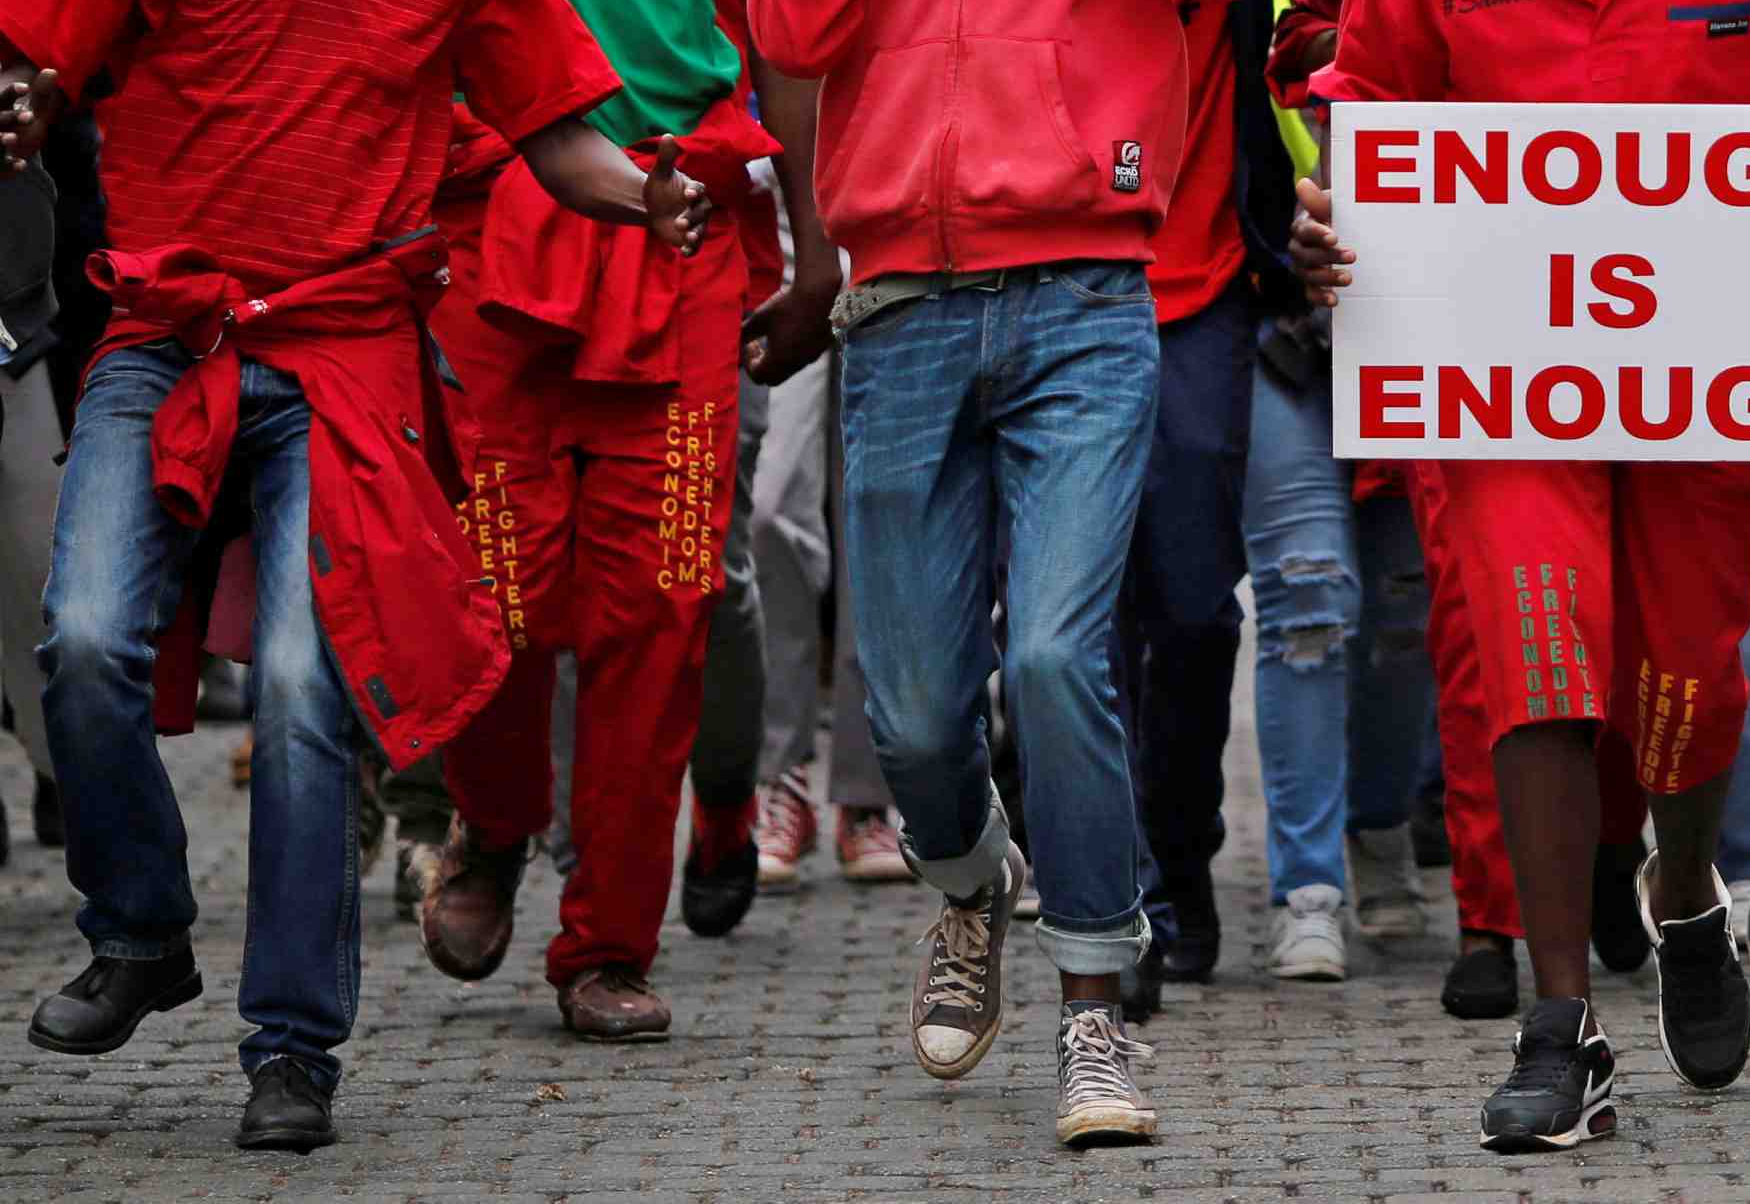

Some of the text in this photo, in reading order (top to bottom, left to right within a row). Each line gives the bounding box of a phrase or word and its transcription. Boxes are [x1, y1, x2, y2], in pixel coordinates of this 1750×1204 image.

[1548, 253, 1657, 329] IS
[494, 461, 528, 649] FIGHTERS
[656, 403, 680, 590] ECONOMIC
[678, 411, 701, 584] FREEDOM
[700, 402, 716, 595] FIGHTERS
